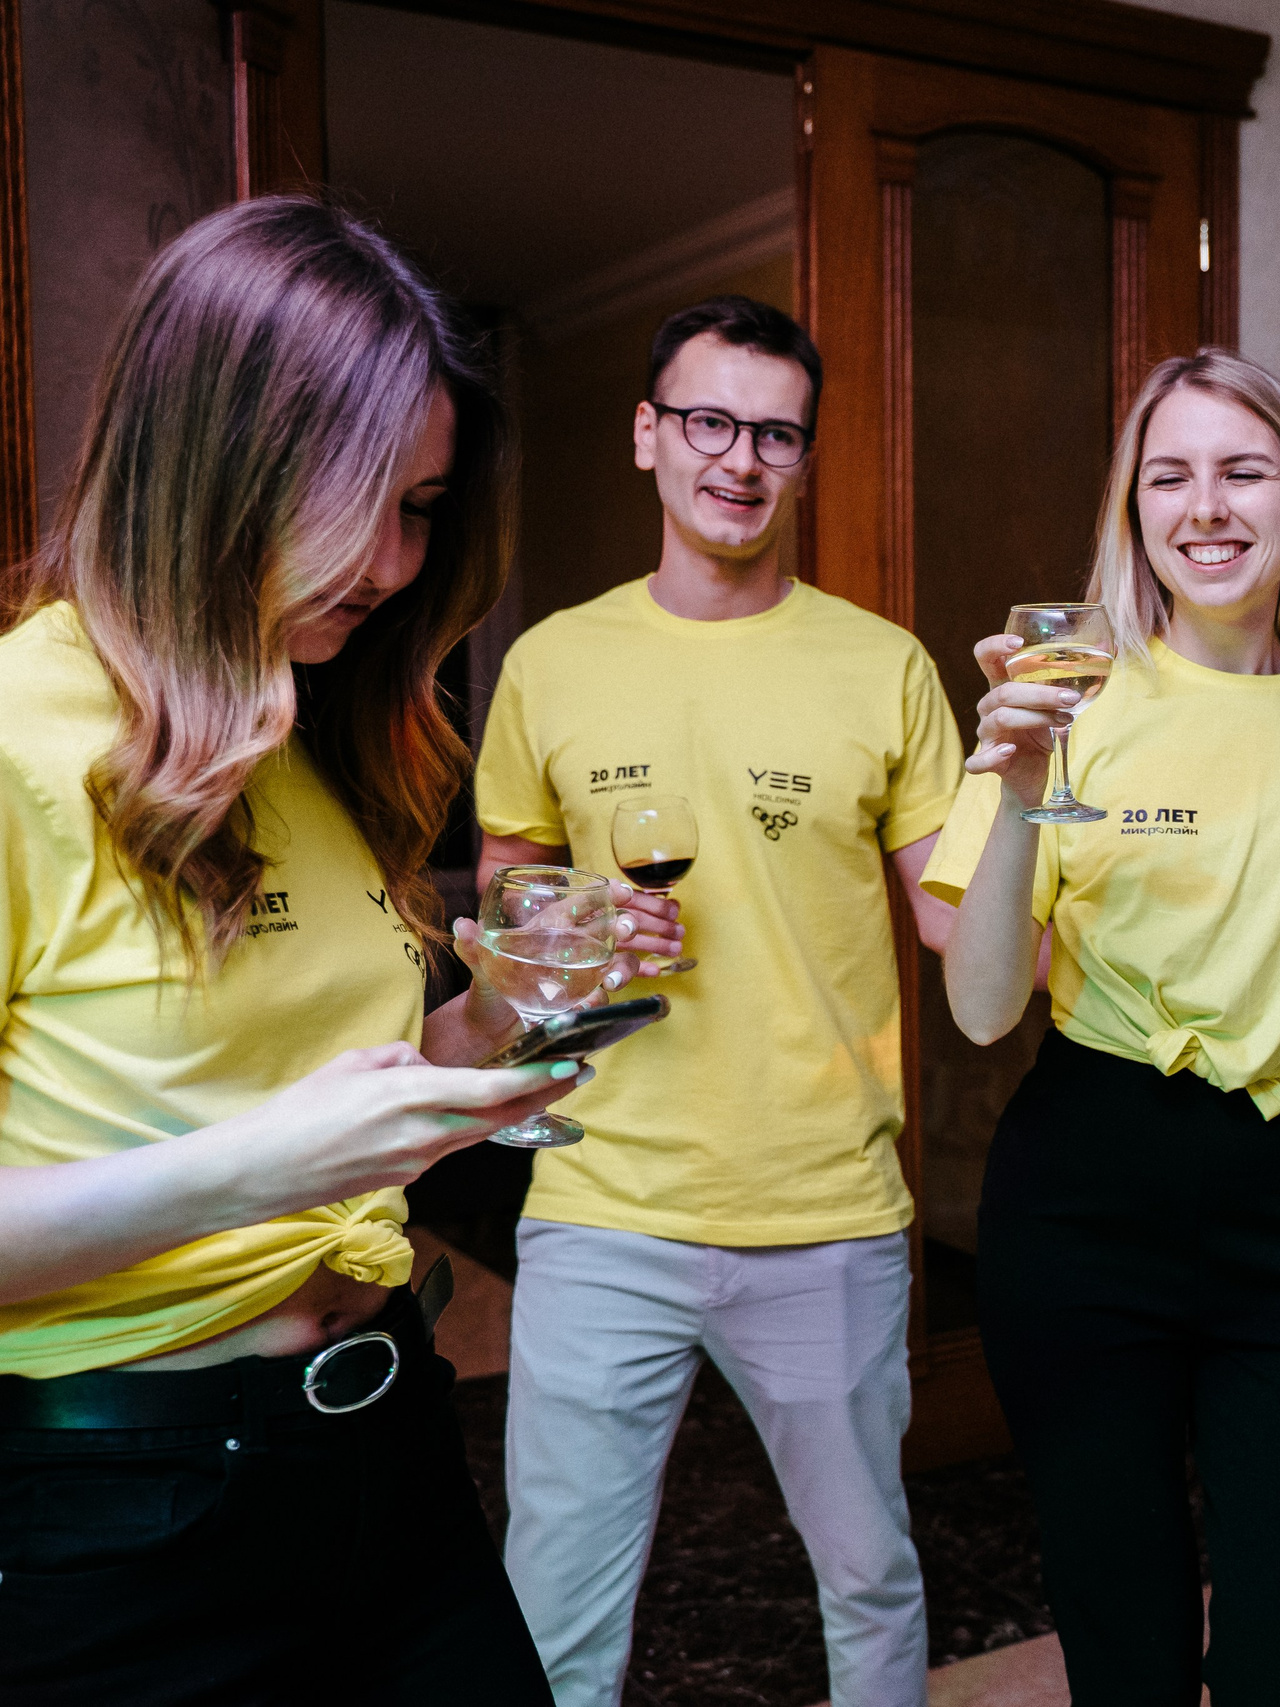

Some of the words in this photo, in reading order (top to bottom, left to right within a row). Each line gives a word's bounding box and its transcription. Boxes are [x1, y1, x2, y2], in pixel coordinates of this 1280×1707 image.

[590, 769, 608, 783] 20
[614, 764, 651, 779] ЛЕТ
[748, 768, 811, 793] YES
[1122, 809, 1148, 823] 20
[1155, 808, 1198, 824] ЛЕТ
[1120, 825, 1199, 837] микролайн
